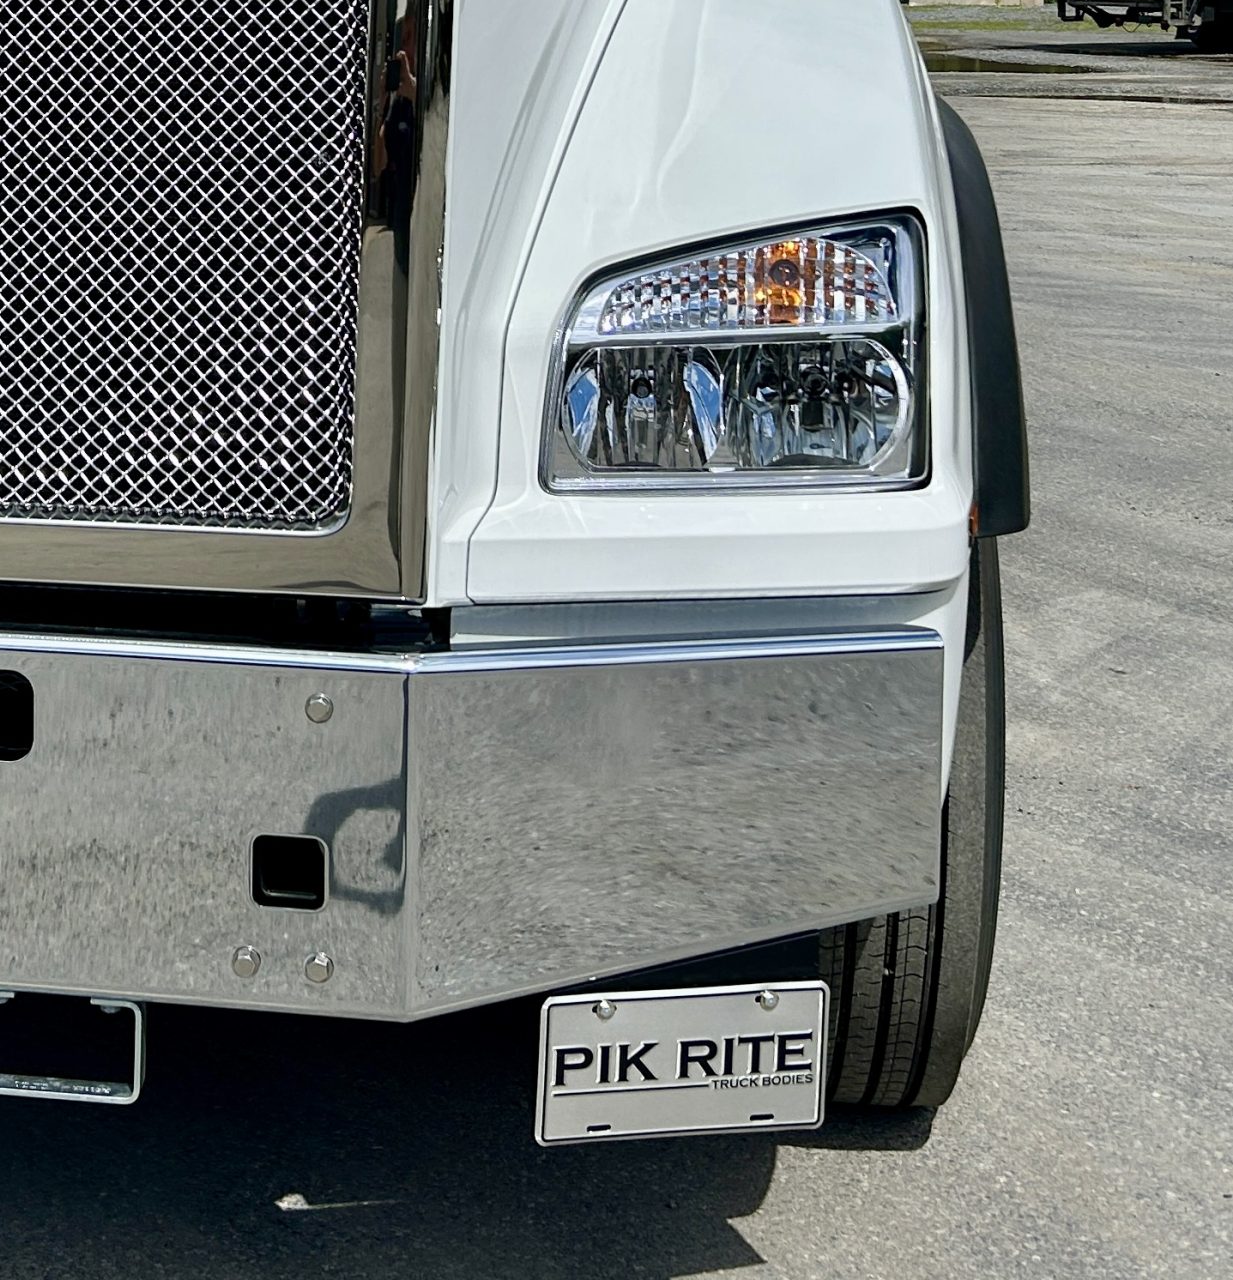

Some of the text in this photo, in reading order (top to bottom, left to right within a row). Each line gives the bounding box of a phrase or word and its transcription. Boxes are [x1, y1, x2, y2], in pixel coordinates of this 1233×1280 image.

[552, 1029, 813, 1086] PIK RITE
[712, 1074, 813, 1090] TRUCK BODIES
